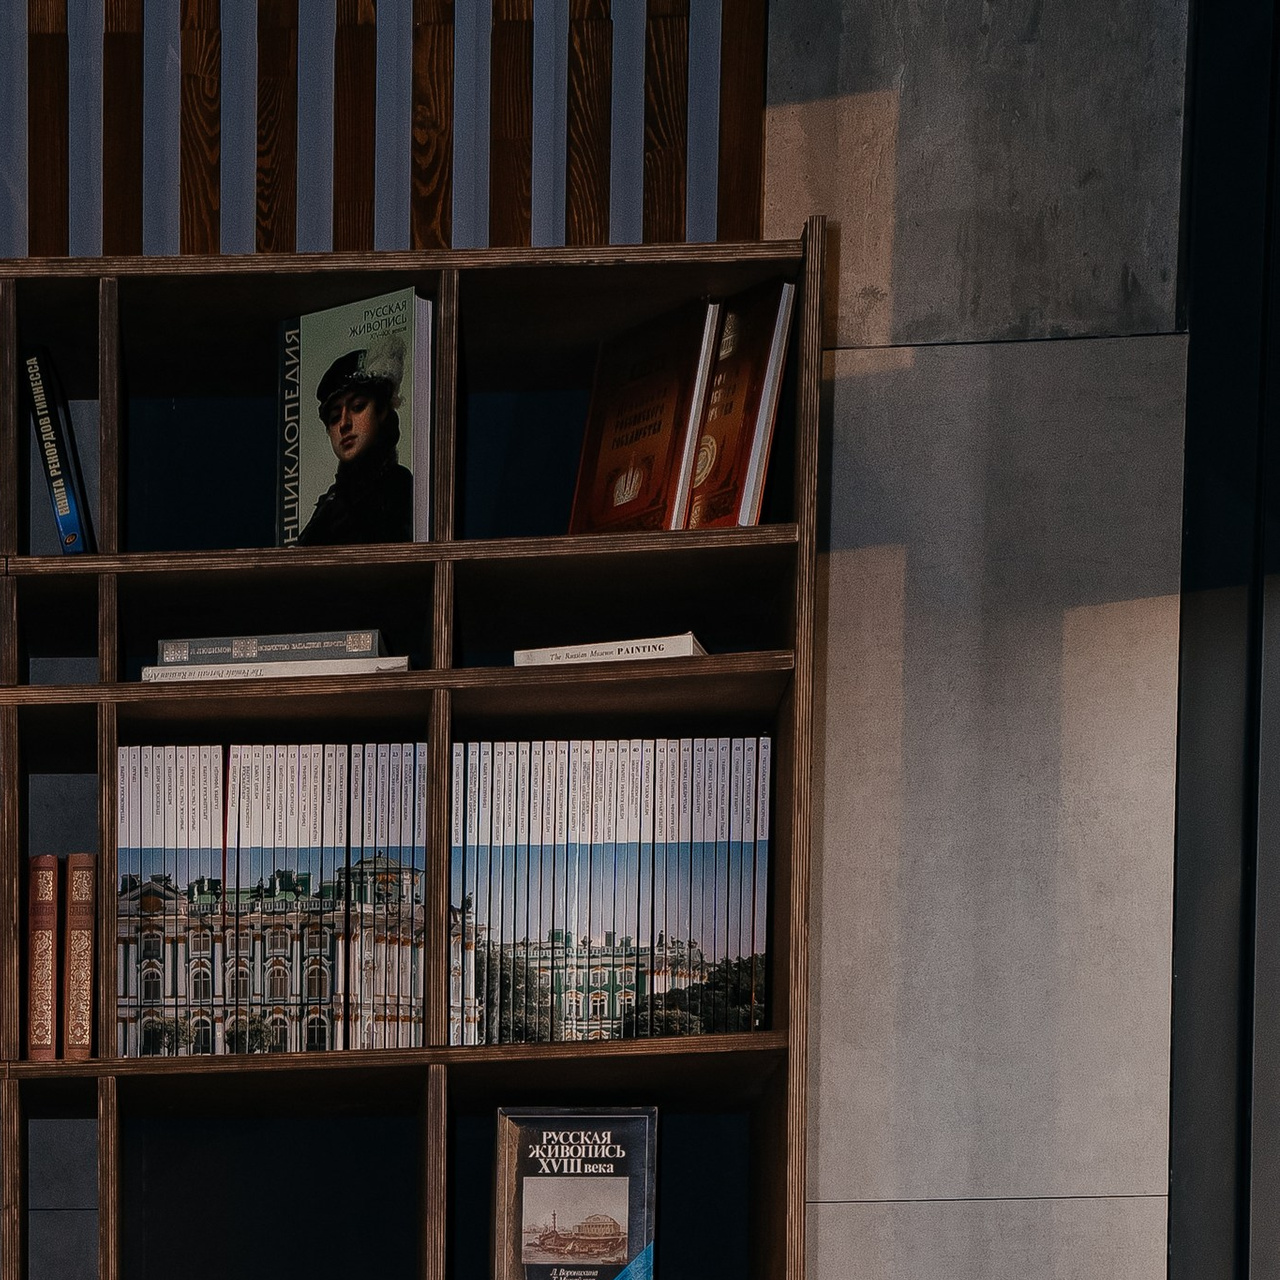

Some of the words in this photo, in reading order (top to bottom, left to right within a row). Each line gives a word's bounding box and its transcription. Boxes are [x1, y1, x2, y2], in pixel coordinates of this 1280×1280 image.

[363, 301, 407, 322] РУССКАЯ
[349, 314, 407, 338] ЖИВОПИСЬ
[26, 356, 49, 415] ГИННЕССА
[40, 417, 63, 477] РЕКОРДОВ
[284, 328, 300, 548] НЦИКЛОПЕДИЯ
[566, 652, 587, 660] Russian
[617, 644, 665, 655] PAINTING
[542, 1131, 612, 1145] РУССКАЯ
[528, 1144, 626, 1159] ЖИВОПИСЬ
[538, 1159, 583, 1174] XVIII
[584, 1162, 614, 1174] века
